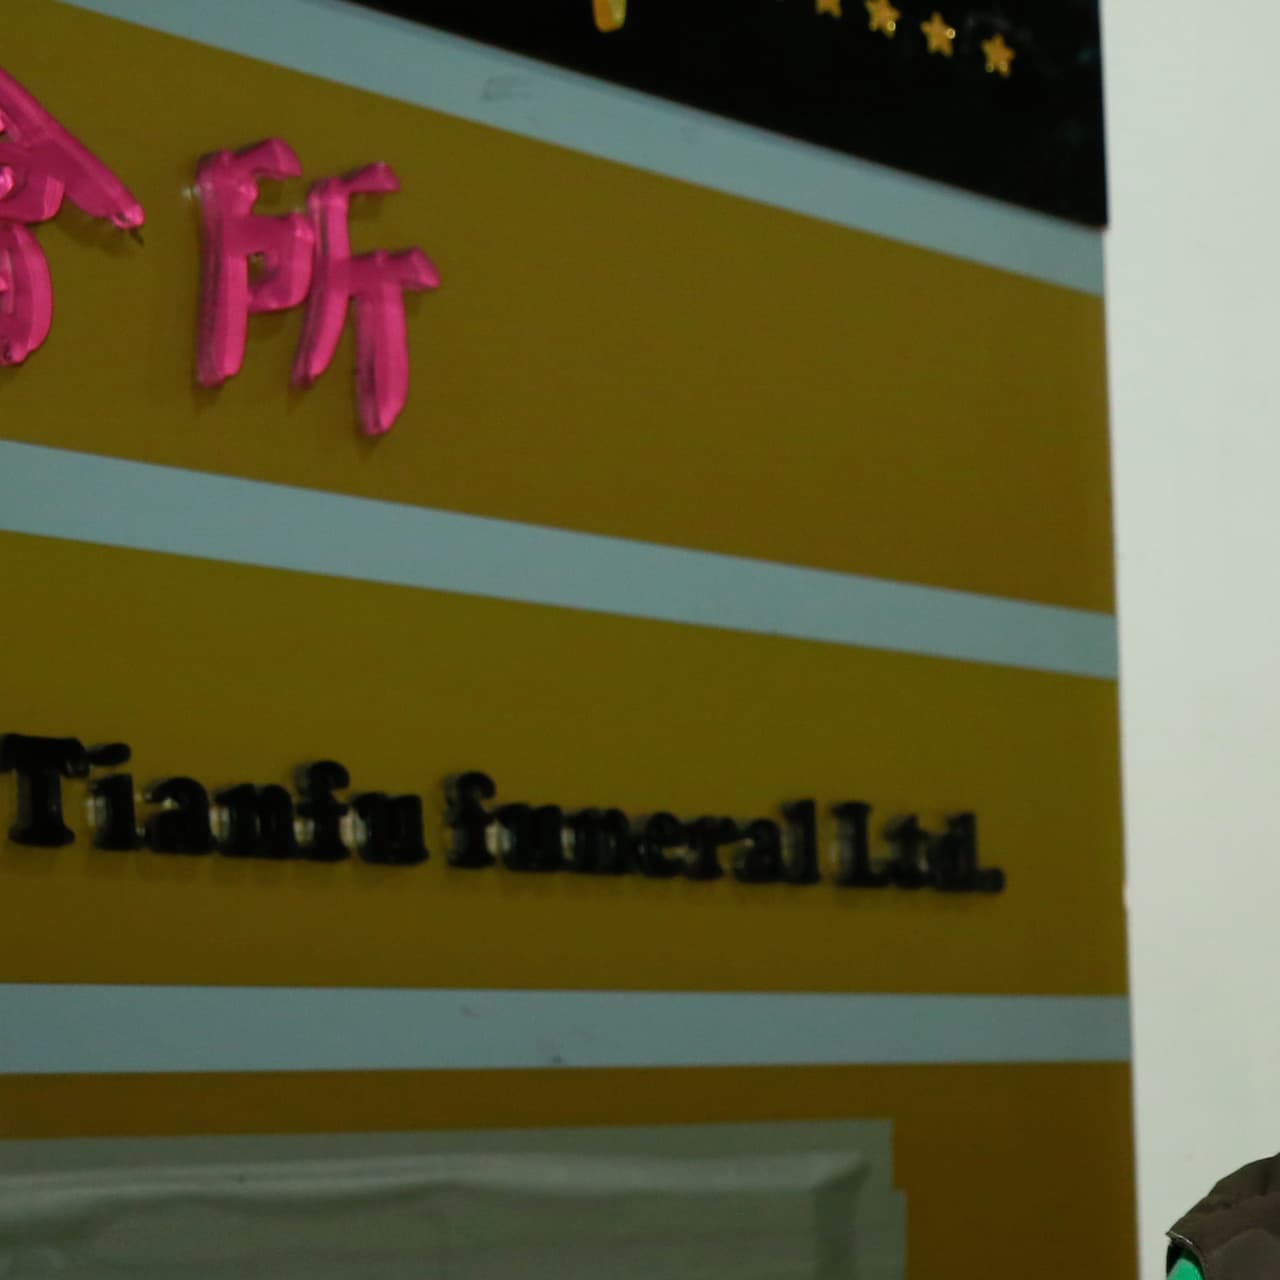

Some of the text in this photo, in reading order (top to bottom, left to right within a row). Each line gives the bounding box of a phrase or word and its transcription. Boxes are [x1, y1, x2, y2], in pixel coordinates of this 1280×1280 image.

[0, 733, 1004, 893] Tianfu funeral Ltd.
